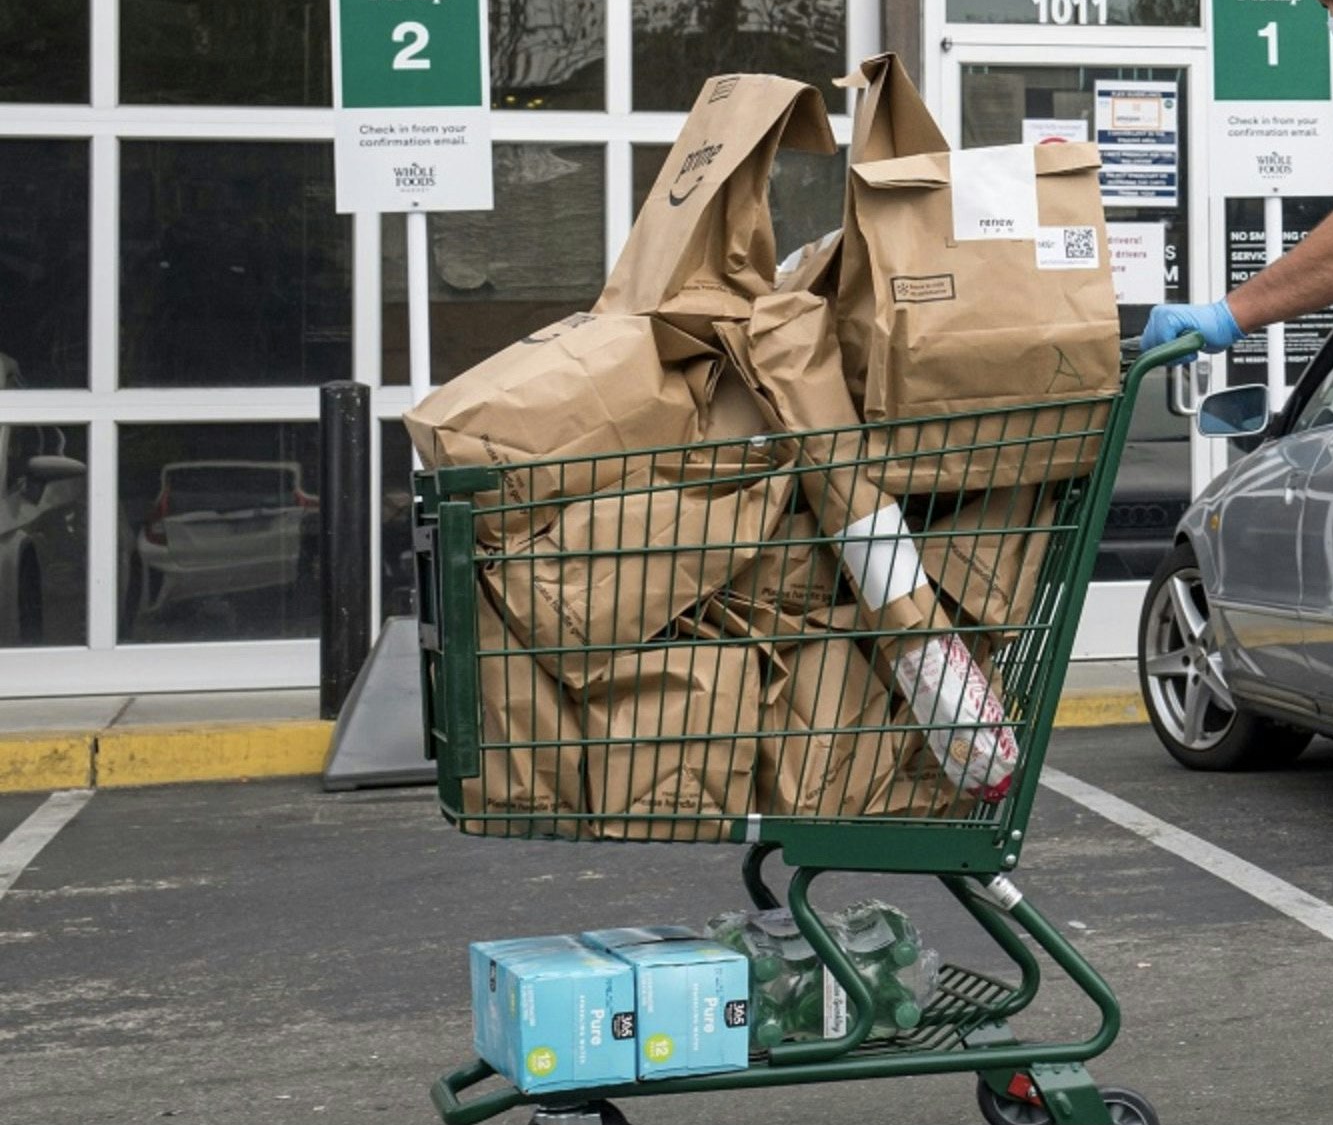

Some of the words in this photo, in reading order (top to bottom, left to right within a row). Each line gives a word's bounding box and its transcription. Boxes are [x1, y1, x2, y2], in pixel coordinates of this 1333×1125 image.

[391, 20, 431, 71] 2
[1257, 20, 1279, 66] 1
[1228, 115, 1258, 125] Check
[1261, 116, 1271, 125] in
[1272, 115, 1295, 125] from
[1297, 117, 1318, 127] your
[359, 124, 395, 135] Check
[399, 124, 409, 134] in
[411, 124, 439, 134] from
[442, 125, 467, 137] your
[1228, 128, 1289, 137] confirmation
[359, 136, 431, 147] confirmation
[393, 164, 436, 177] WHOLE
[395, 177, 436, 187] FOODS
[1230, 232, 1248, 241] NO
[1250, 231, 1299, 241] SMNG
[1231, 272, 1248, 281] NO
[703, 996, 719, 1034] Pure
[733, 1001, 745, 1026] 365
[590, 1008, 605, 1046] Pure
[621, 1014, 634, 1038] 365
[655, 1039, 669, 1057] 12
[537, 1052, 551, 1070] 12
